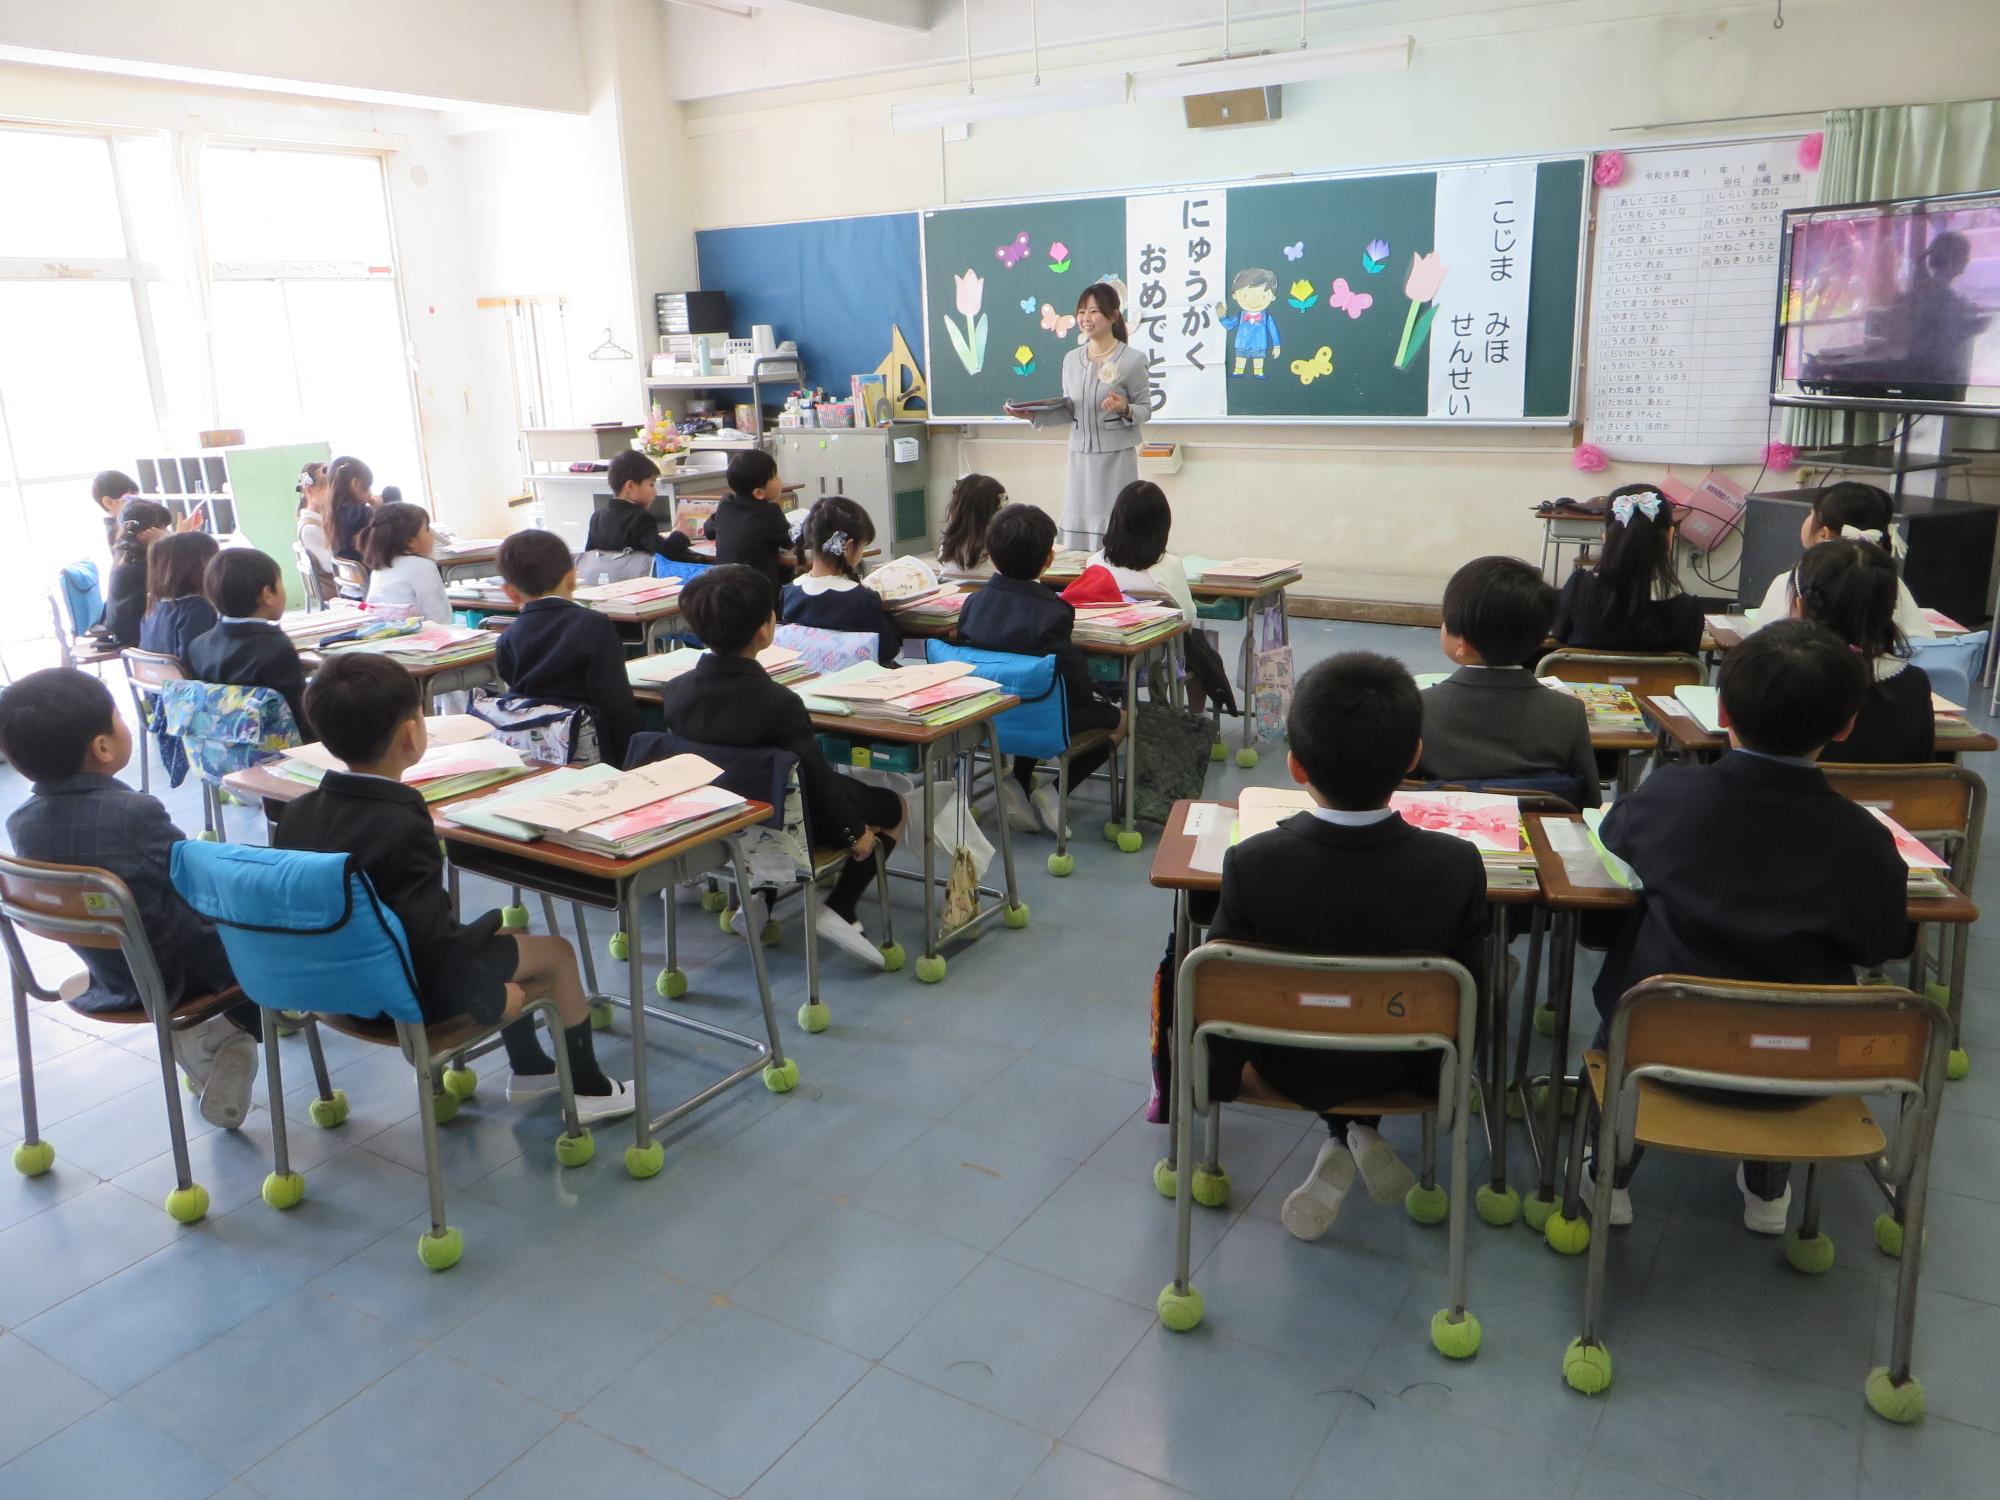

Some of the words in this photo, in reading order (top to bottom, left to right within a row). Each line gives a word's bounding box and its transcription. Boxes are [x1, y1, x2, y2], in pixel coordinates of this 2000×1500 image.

[1720, 164, 1728, 174] 年
[1758, 162, 1767, 172] 組
[1724, 178, 1741, 186] 担任
[1620, 197, 1646, 206] あした
[1652, 194, 1678, 203] こはる
[1619, 209, 1654, 218] いちむら
[1659, 207, 1686, 216] ゆりな
[1717, 216, 1753, 225] あいかわ
[1618, 223, 1644, 232] ながた
[1714, 230, 1732, 239] つじ
[1738, 228, 1766, 237] みそら
[1489, 200, 1517, 282] こじま
[1640, 234, 1664, 244] あいこ
[1714, 243, 1740, 252] かねこ
[1748, 242, 1775, 250] そうと
[1616, 249, 1642, 257] よこい
[1713, 256, 1740, 265] あらき
[1747, 254, 1776, 264] ひろと
[1181, 199, 1212, 372] にゅうがく
[1613, 300, 1647, 308] たてまつ
[1643, 311, 1668, 319] なつと
[1138, 244, 1168, 414] おめでとう
[1612, 325, 1647, 333] なりまつ
[1485, 312, 1511, 364] みほ
[1611, 337, 1636, 345] うえの
[1643, 336, 1658, 344] りお
[1448, 315, 1474, 416] せんせい
[1641, 360, 1684, 369] こうたろう
[1648, 373, 1687, 381] りょうゆう
[1608, 386, 1642, 394] わたぬき
[1648, 385, 1665, 394] なお
[1648, 398, 1671, 406] あおと
[1607, 422, 1639, 431] さいとう
[1387, 991, 1405, 1017] 6
